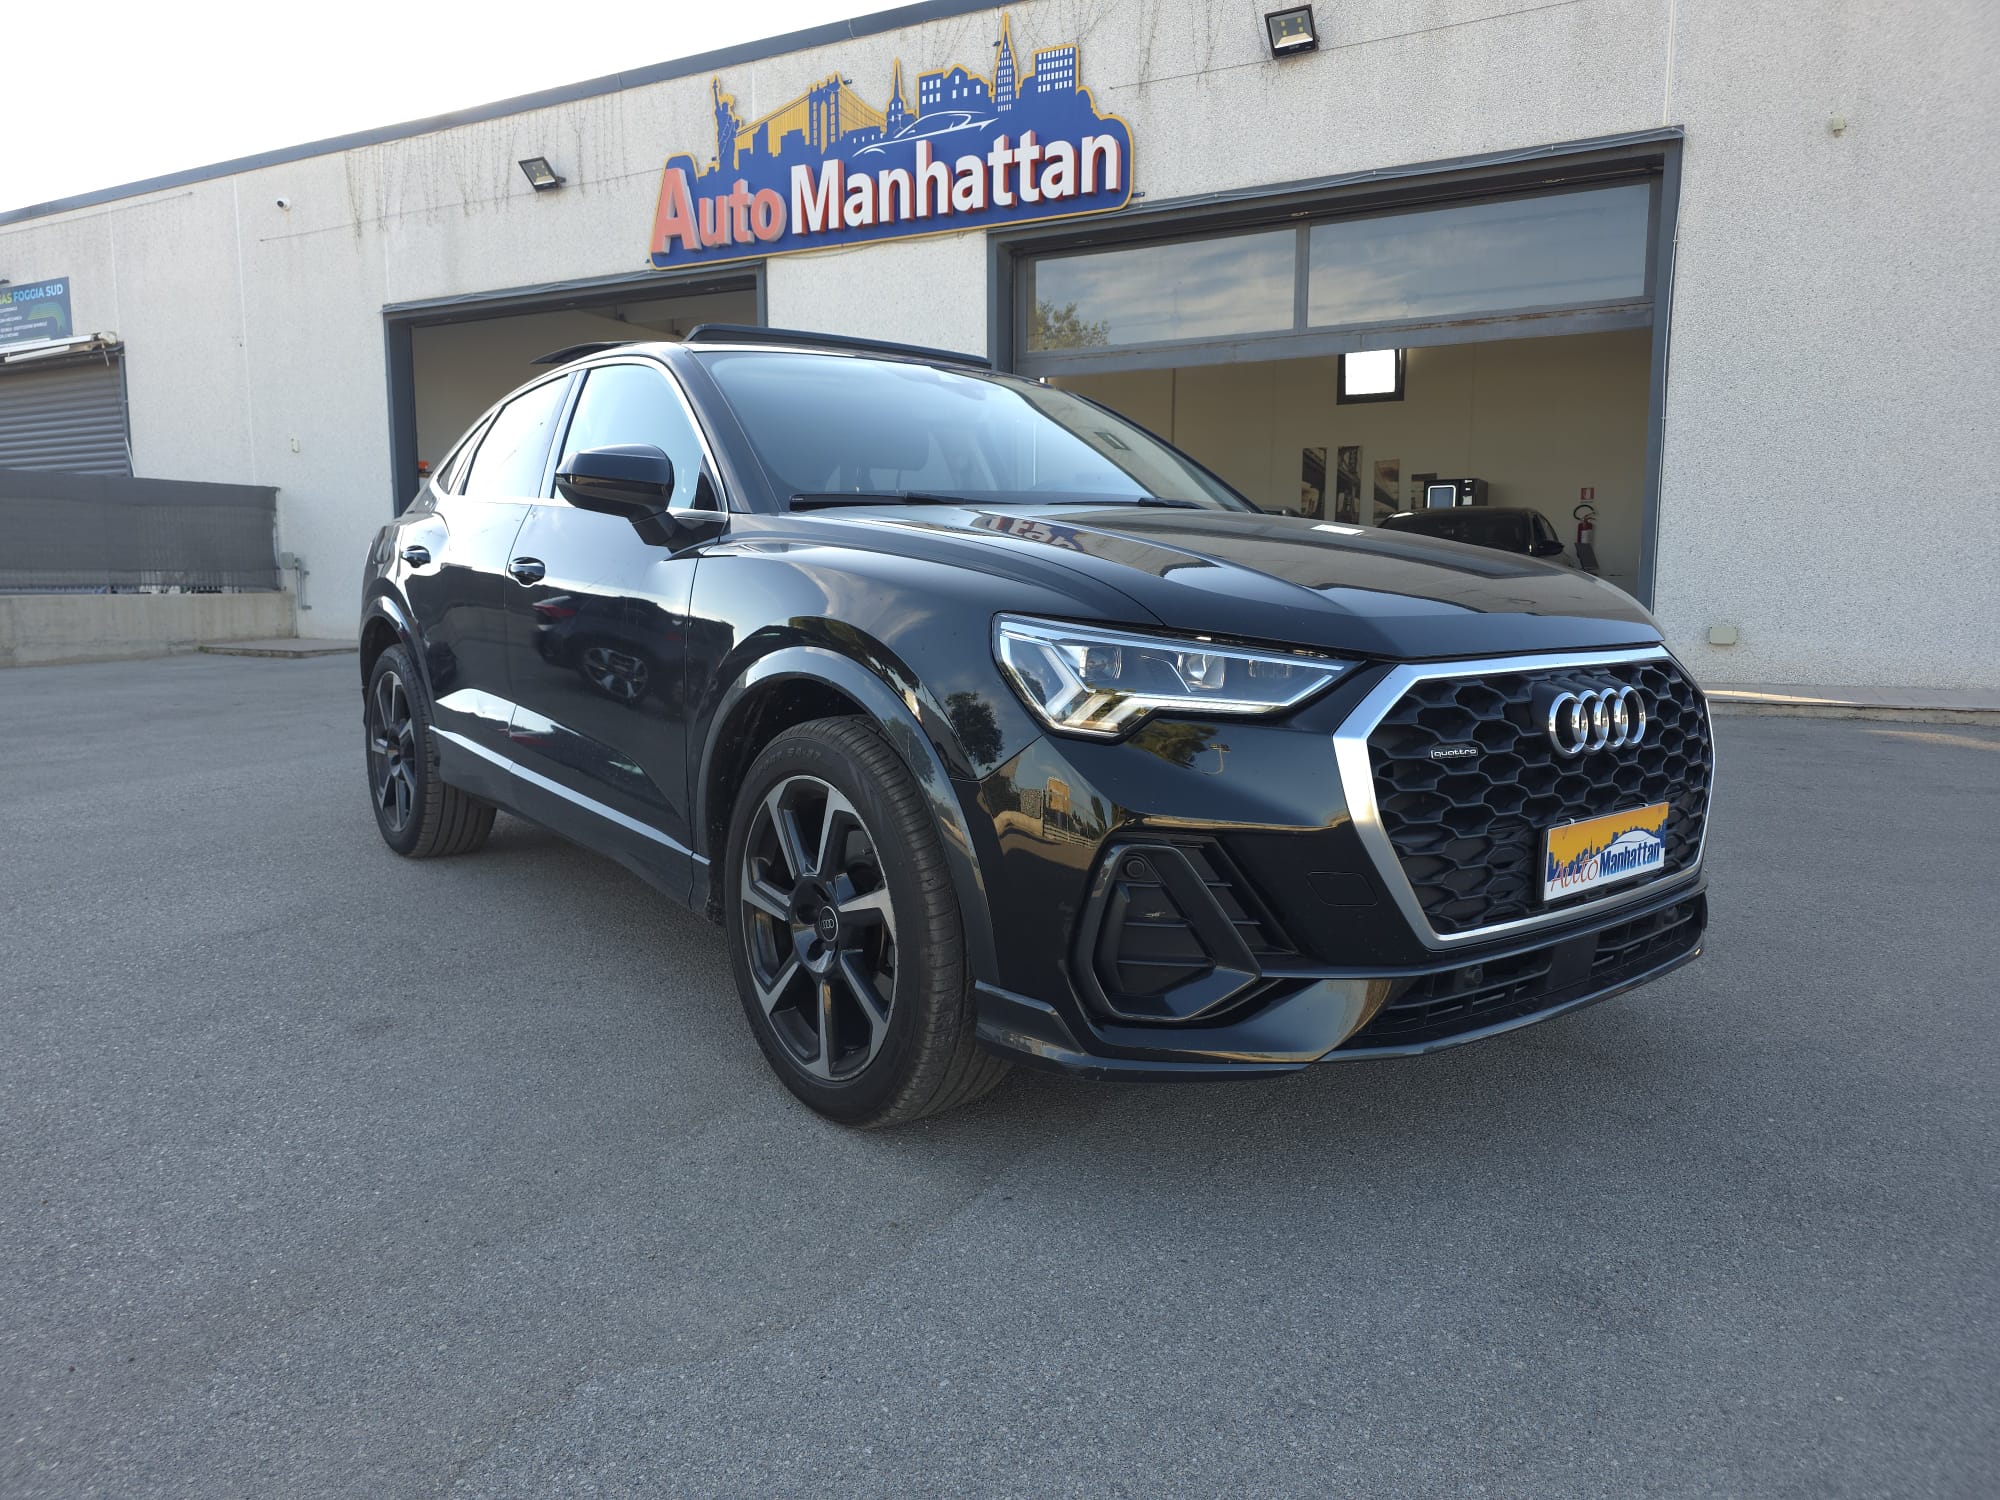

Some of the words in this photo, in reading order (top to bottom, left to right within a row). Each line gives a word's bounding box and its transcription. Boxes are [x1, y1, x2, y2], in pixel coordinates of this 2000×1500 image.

[651, 167, 787, 254] Auto
[791, 130, 1122, 236] Manhattan
[13, 287, 45, 302] FOGGIA
[46, 284, 63, 297] SUD
[1434, 749, 1476, 757] quattro
[1550, 856, 1599, 892] Auto
[1599, 841, 1660, 878] Manhattan
